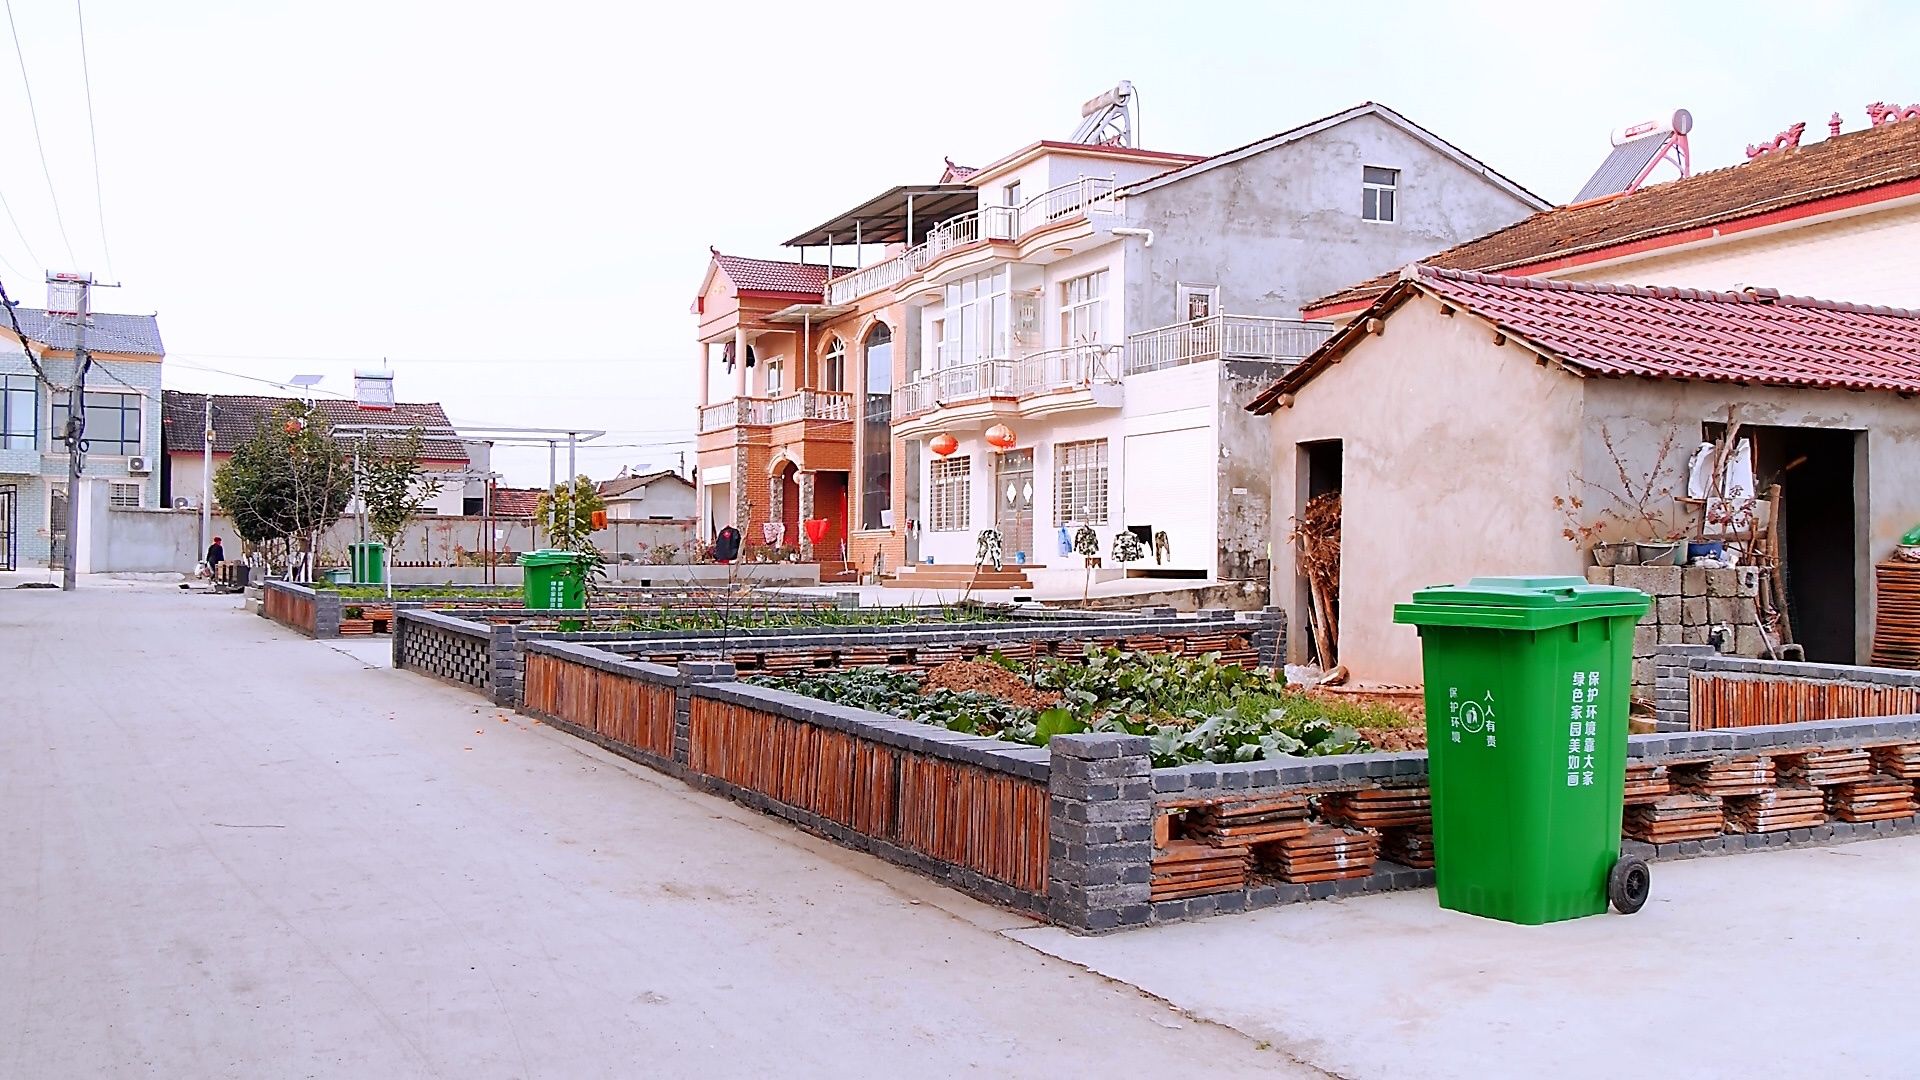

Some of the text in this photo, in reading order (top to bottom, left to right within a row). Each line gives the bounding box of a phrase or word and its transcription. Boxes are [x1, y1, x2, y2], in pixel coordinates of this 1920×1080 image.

[1449, 687, 1461, 743] 保护环境
[1484, 690, 1497, 748] 人人有责
[1567, 671, 1585, 787] 绿色家园美如画
[1582, 671, 1600, 786] 保护环境靠大家
